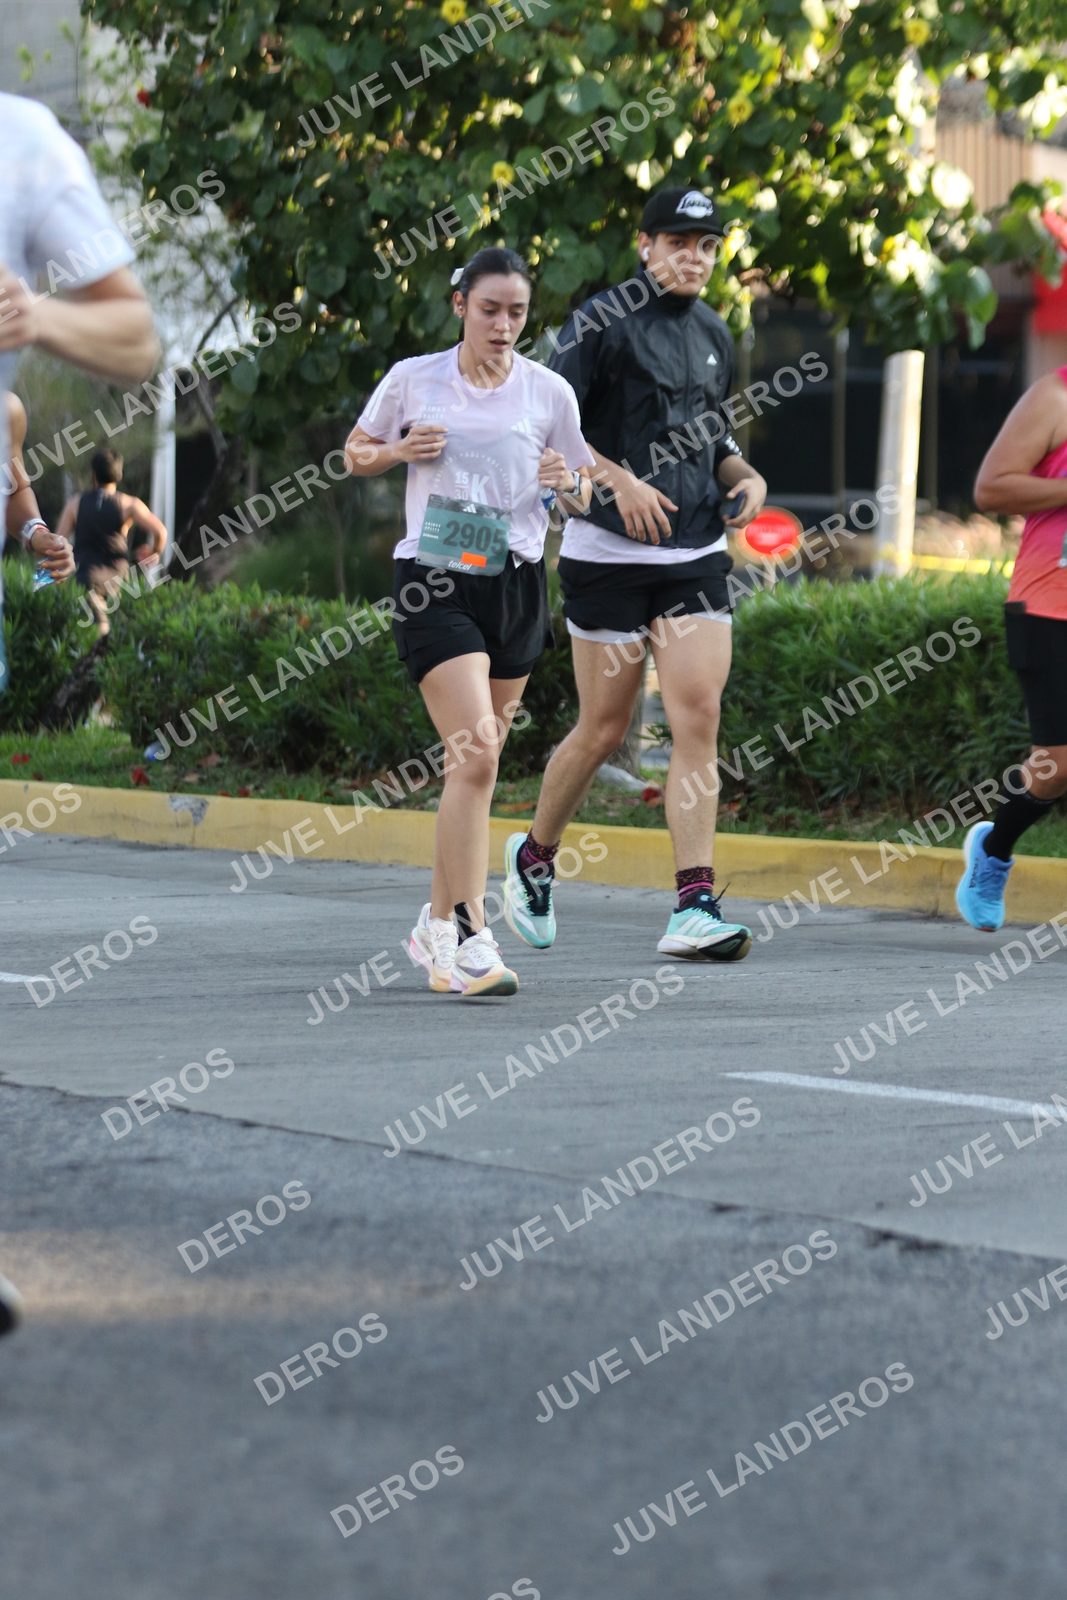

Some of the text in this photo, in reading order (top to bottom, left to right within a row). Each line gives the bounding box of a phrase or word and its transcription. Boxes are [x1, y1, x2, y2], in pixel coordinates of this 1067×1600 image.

[455, 471, 469, 485] 15
[471, 473, 490, 504] K
[443, 520, 508, 556] 2905
[448, 560, 472, 571] telcel
